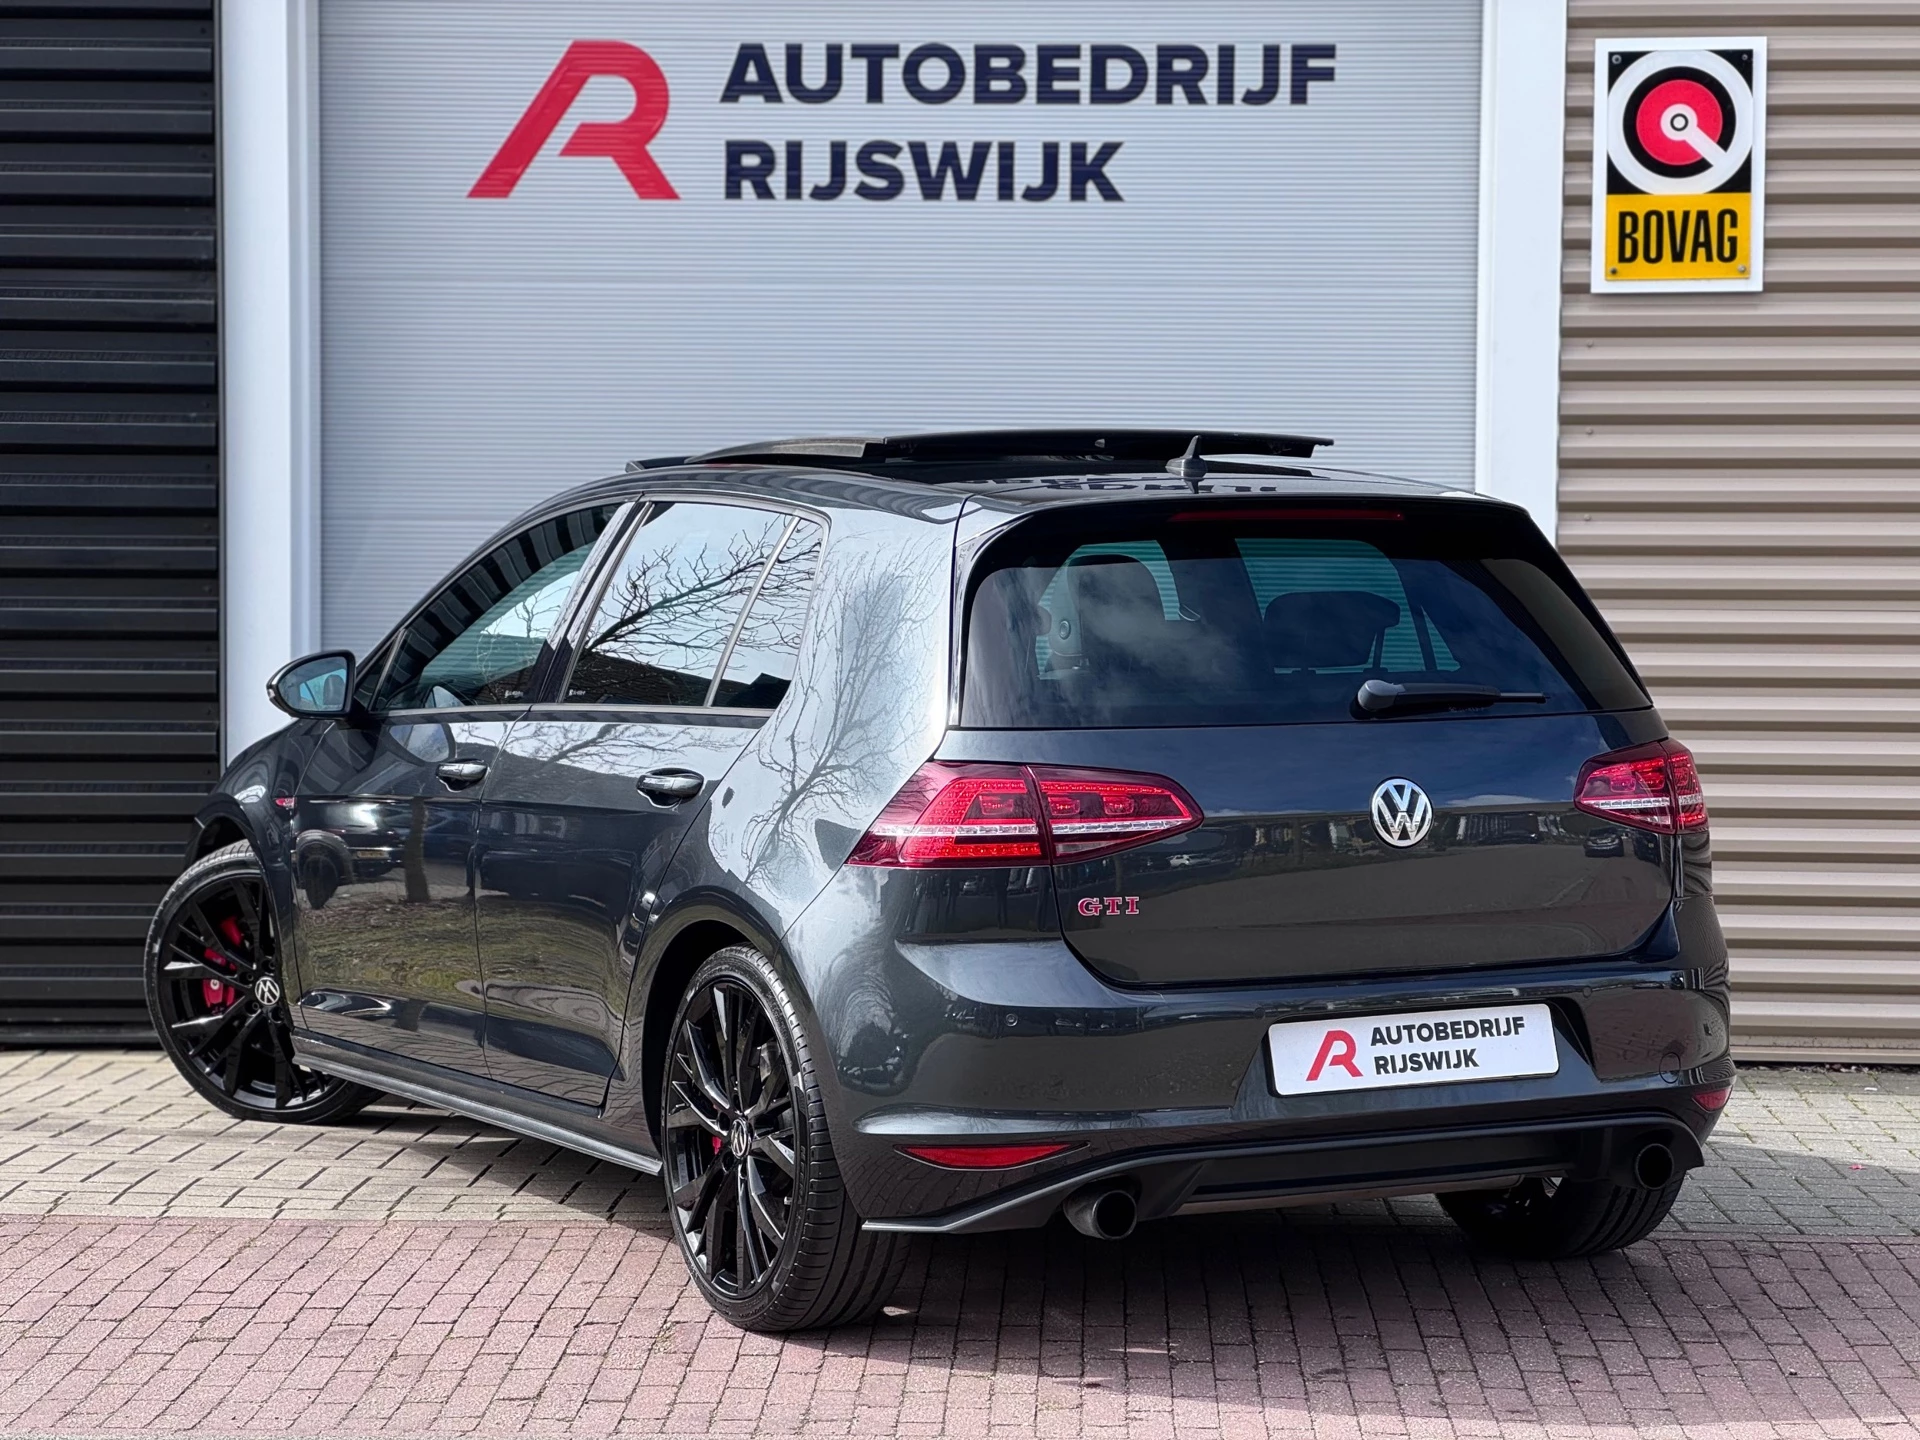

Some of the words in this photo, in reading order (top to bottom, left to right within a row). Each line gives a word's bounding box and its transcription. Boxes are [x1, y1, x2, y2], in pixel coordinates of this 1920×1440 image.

[720, 42, 1336, 105] AUTOBEDRIJF
[724, 140, 1125, 202] RIJSWIJK
[1617, 208, 1738, 264] BOVAG
[1077, 896, 1140, 916] GTI
[1370, 1016, 1525, 1046] AUTOBEDRIJF
[1373, 1048, 1480, 1075] RIJSWIJK
